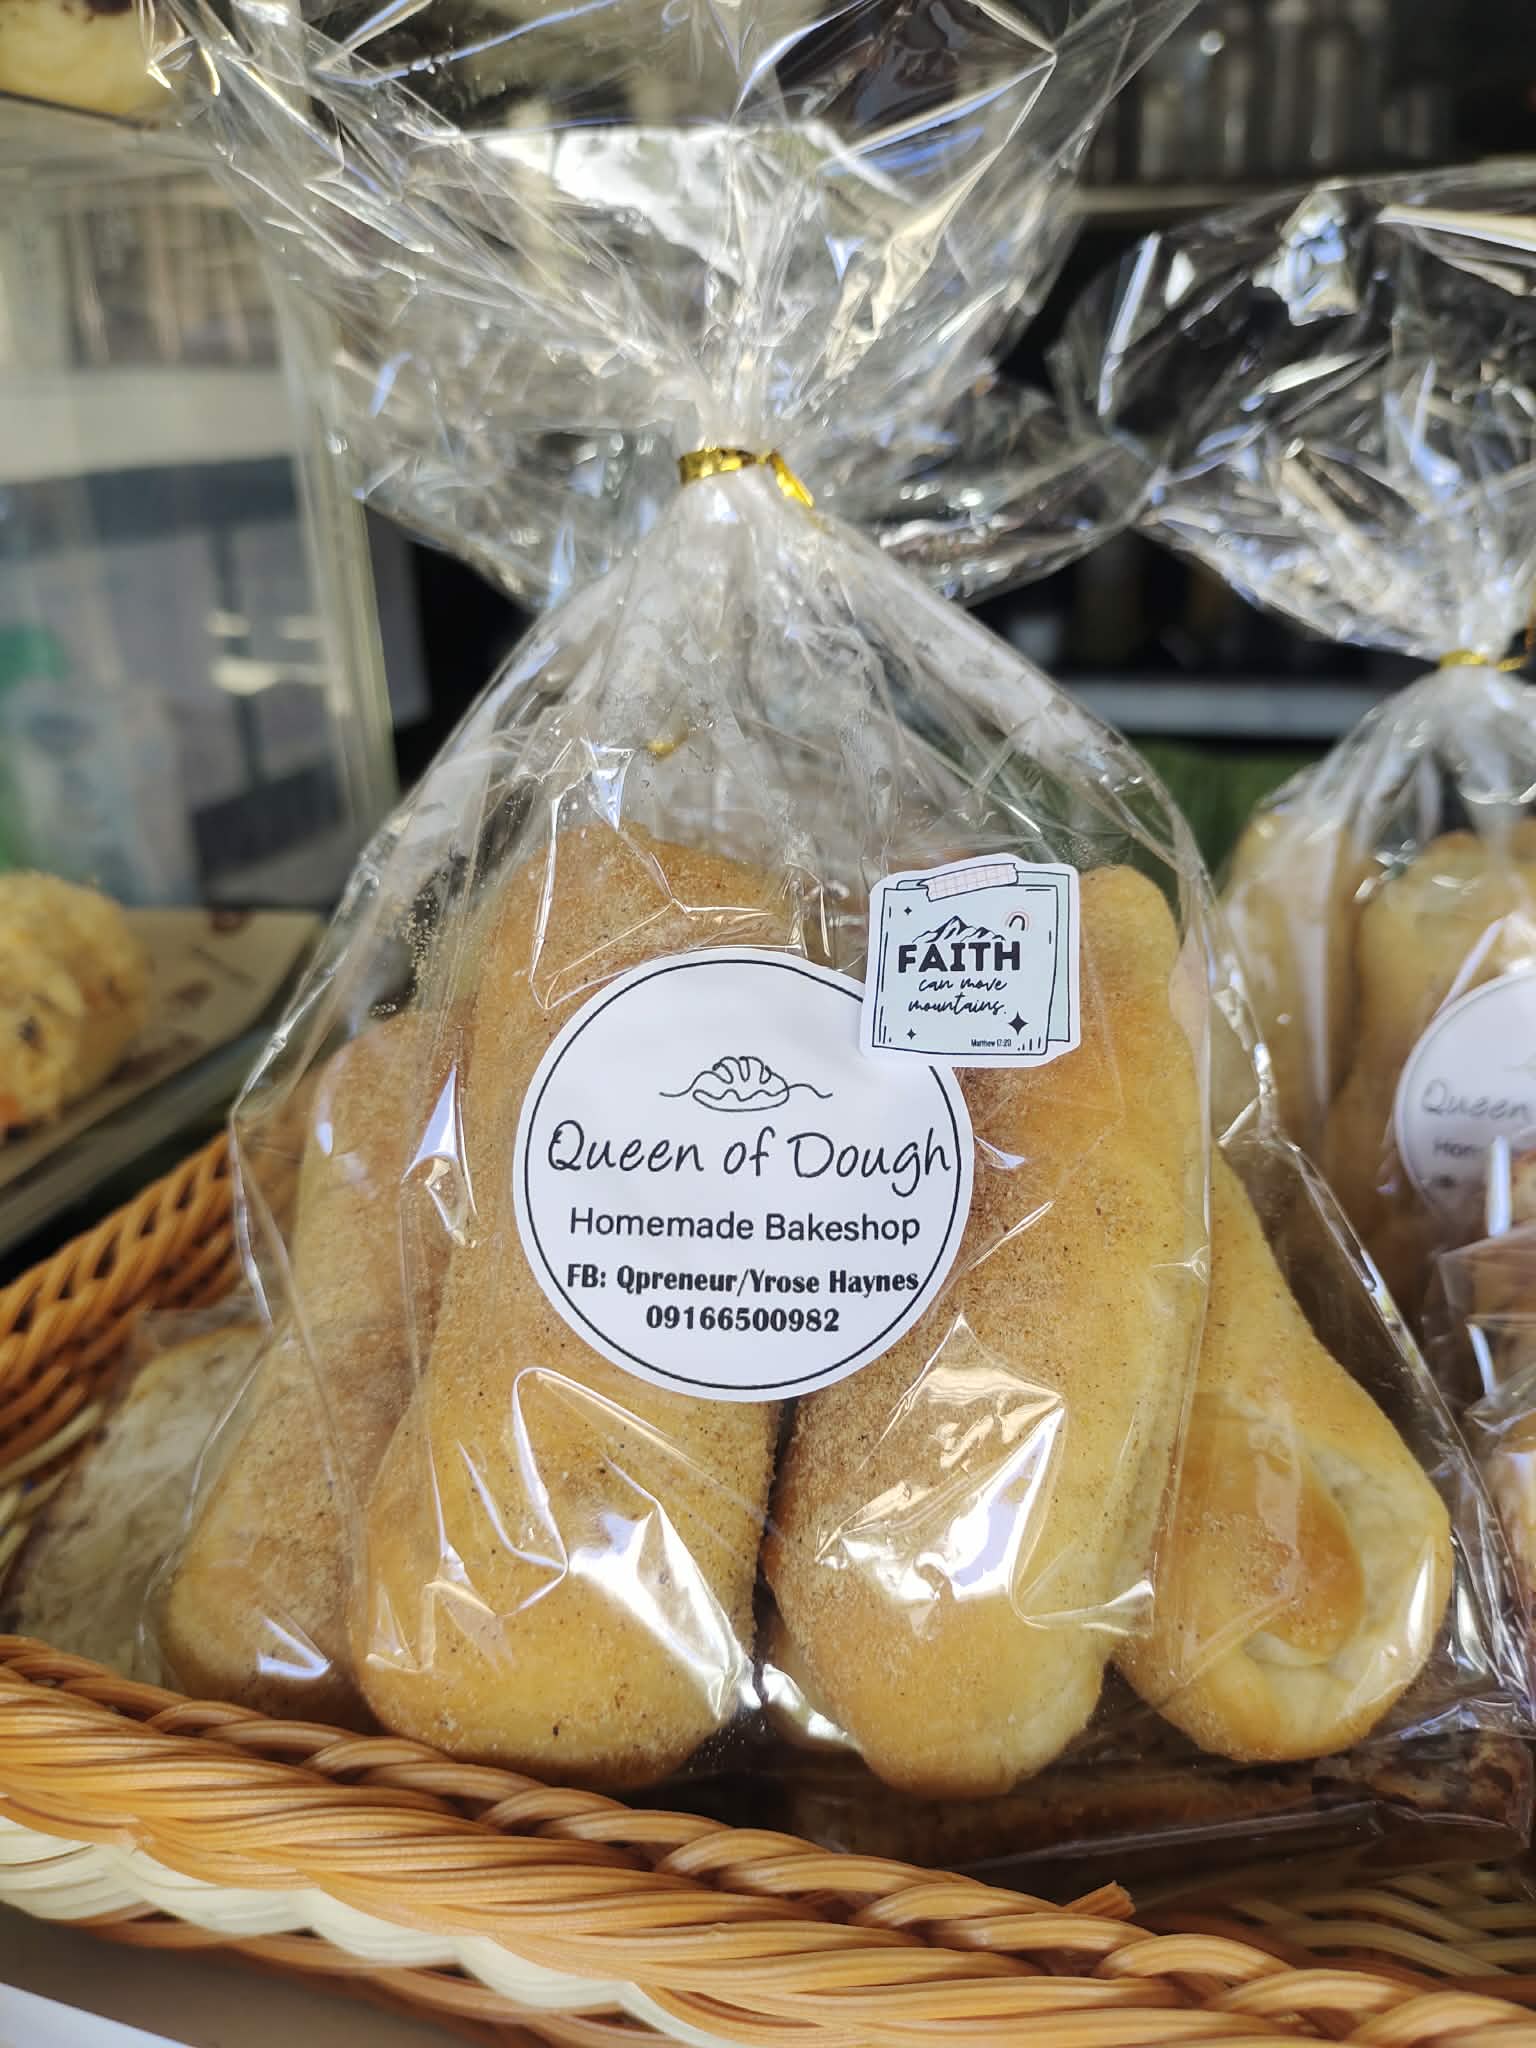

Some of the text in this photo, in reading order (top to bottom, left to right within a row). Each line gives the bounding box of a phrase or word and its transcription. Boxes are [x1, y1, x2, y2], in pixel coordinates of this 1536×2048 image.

[898, 941, 1020, 973] FAITH
[919, 976, 1008, 992] can move
[908, 992, 1007, 1015] mountains.
[1421, 1079, 1531, 1122] Queen
[548, 1120, 951, 1198] Queen of Dough
[570, 1208, 921, 1245] Homemade Bakeshop
[567, 1264, 919, 1298] FB: Qpreneur/Yrose Haynes
[646, 1305, 840, 1333] 09166500982
